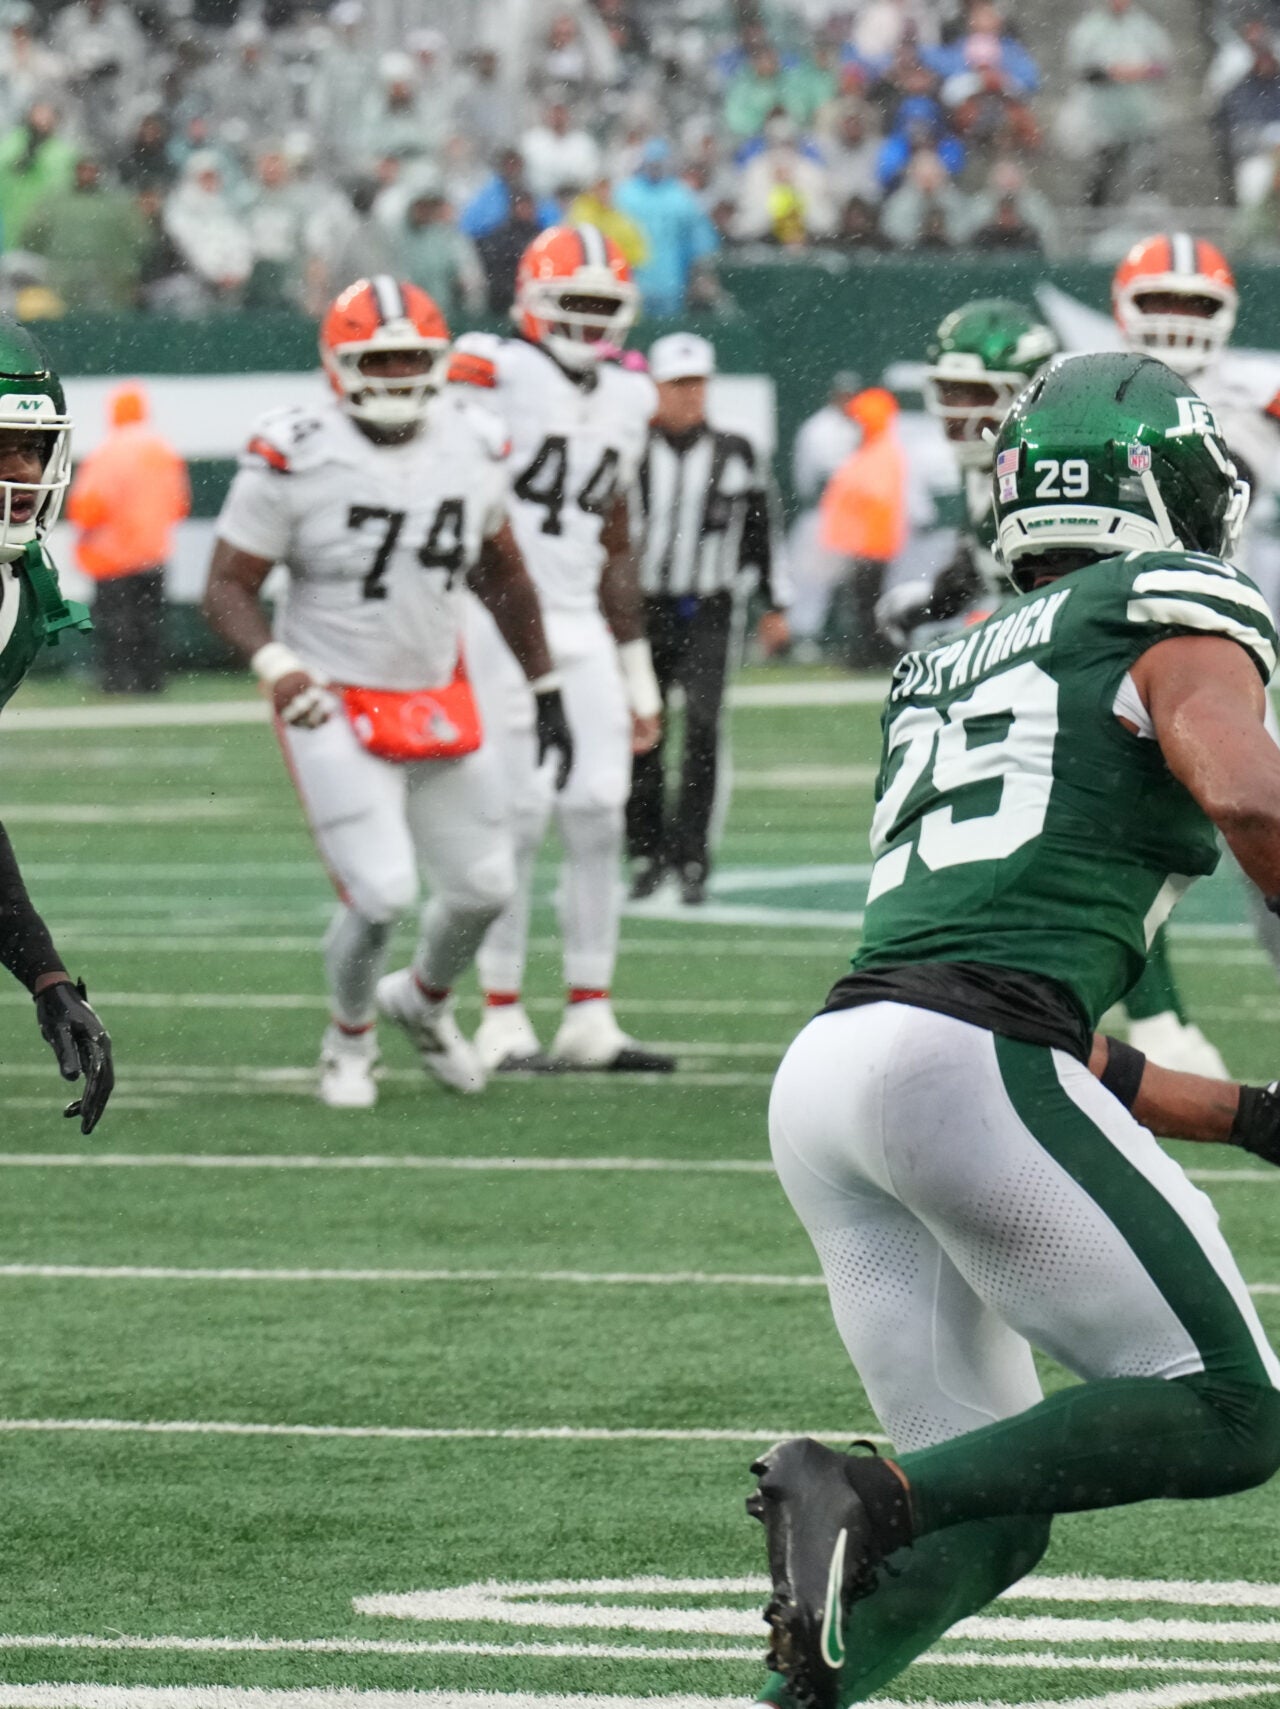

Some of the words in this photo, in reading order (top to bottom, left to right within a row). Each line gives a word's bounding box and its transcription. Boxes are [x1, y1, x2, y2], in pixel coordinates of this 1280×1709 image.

[16, 400, 44, 410] NY
[513, 435, 620, 536] 44
[1034, 459, 1090, 498] 29
[348, 499, 464, 599] 74
[866, 660, 1060, 906] 29
